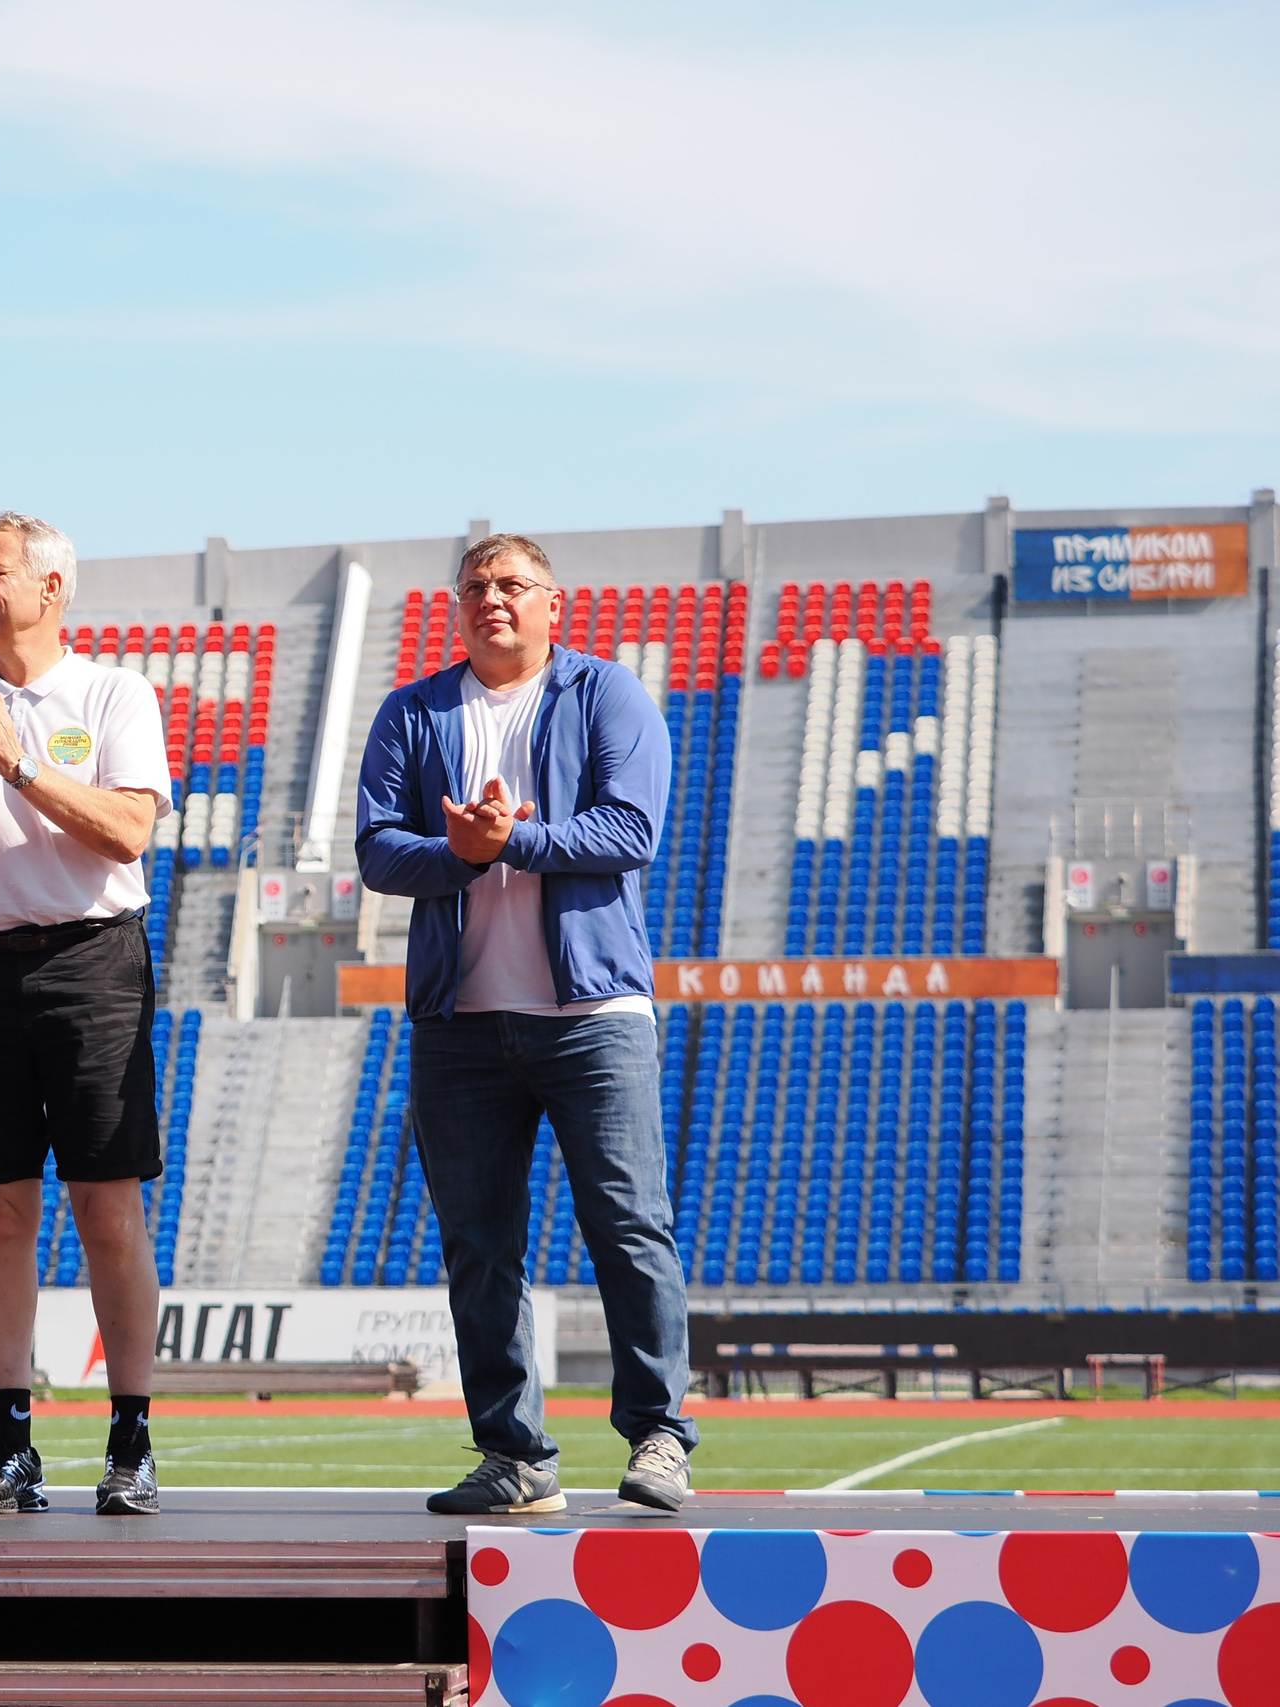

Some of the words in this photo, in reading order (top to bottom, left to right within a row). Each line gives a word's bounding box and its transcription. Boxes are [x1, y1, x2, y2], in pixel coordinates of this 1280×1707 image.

[1052, 531, 1214, 563] ПРЯМИКОМ
[1051, 565, 1095, 594] ИЗ
[1097, 561, 1215, 592] СИБИРИ
[677, 962, 951, 996] КОМАНДА
[156, 1304, 292, 1360] АГАТ
